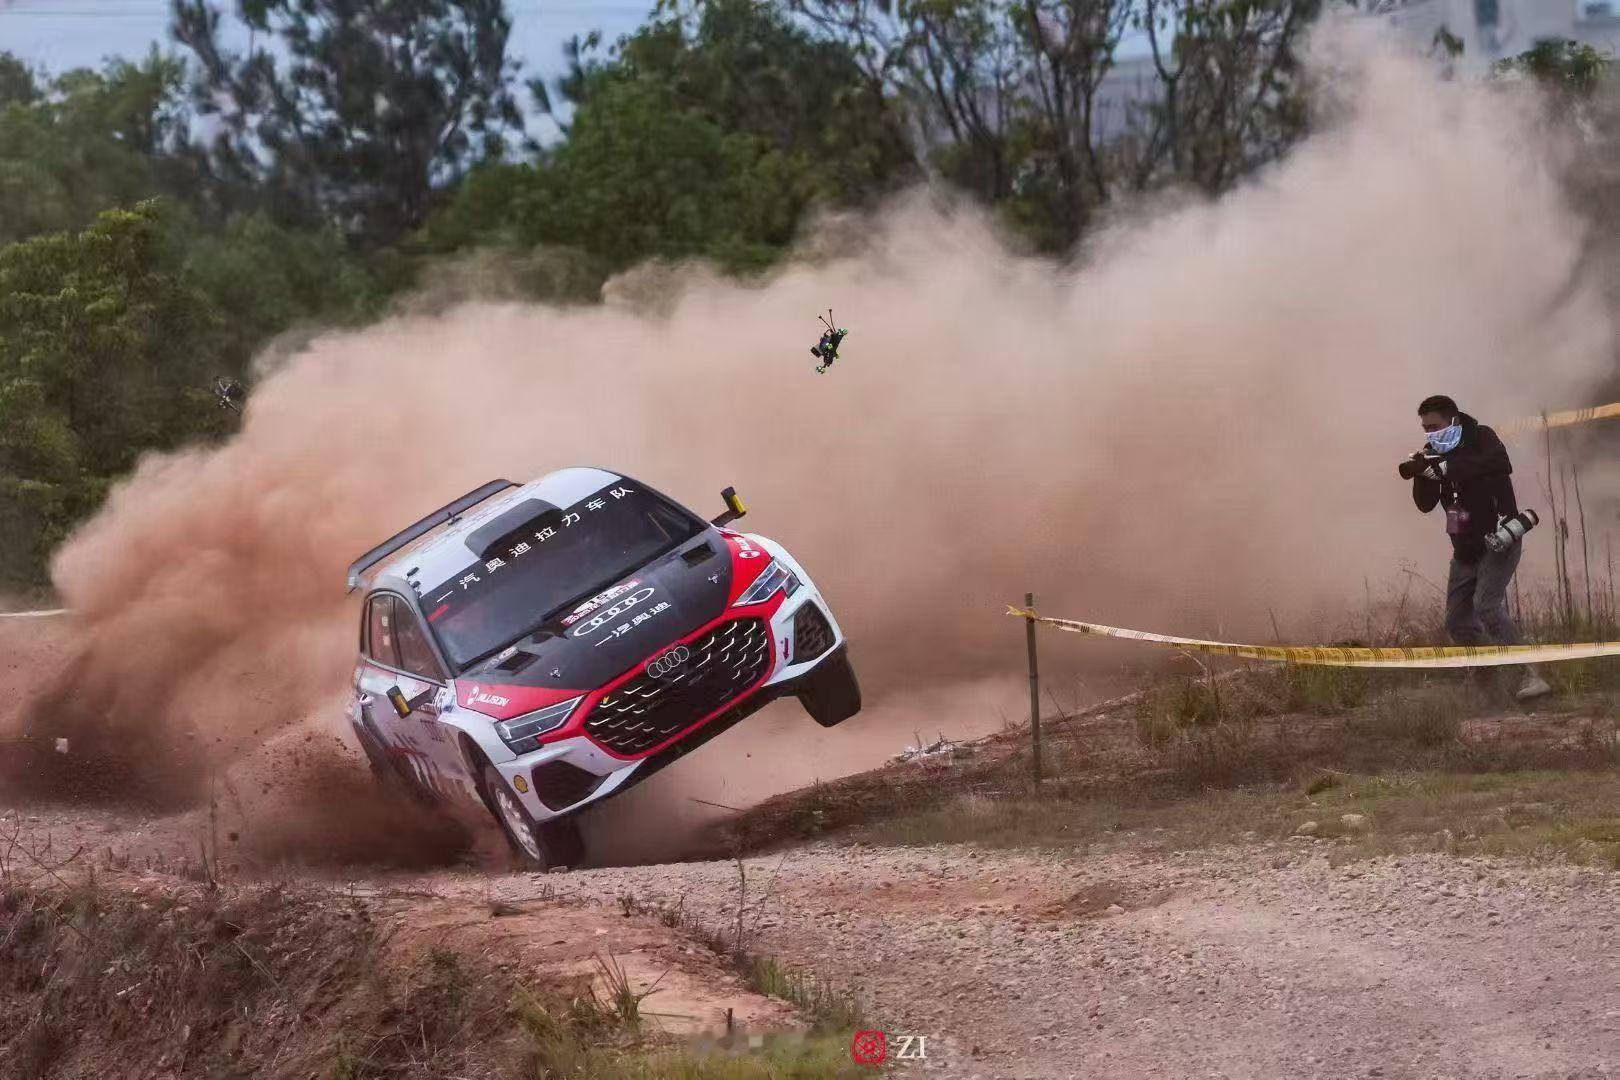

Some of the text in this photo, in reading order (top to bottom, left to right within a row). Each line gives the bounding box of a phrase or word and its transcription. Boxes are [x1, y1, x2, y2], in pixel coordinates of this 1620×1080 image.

[436, 486, 634, 603] 一汽奥迪拉力车队
[594, 601, 672, 647] 一汽奥迪
